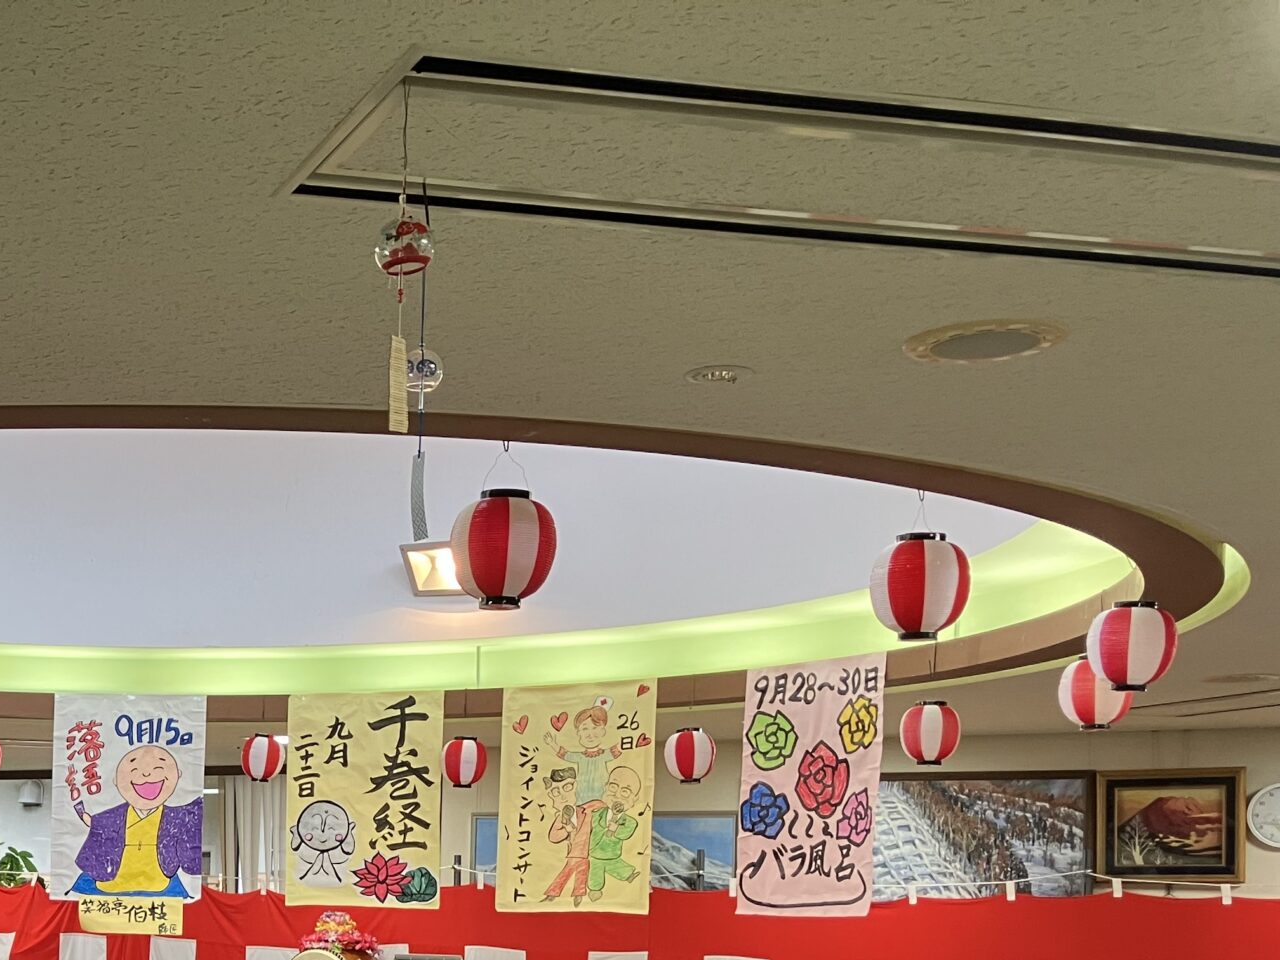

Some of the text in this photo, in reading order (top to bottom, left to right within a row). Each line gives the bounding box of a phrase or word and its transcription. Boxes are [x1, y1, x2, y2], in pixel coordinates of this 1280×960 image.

[65, 720, 104, 802] 落語
[115, 714, 193, 746] 9月15日
[324, 715, 354, 768] 九月
[293, 734, 321, 798] 二十二日
[363, 695, 435, 851] 千巻経
[512, 745, 539, 903] ジョイントコンサート
[749, 840, 856, 881] バラ風呂
